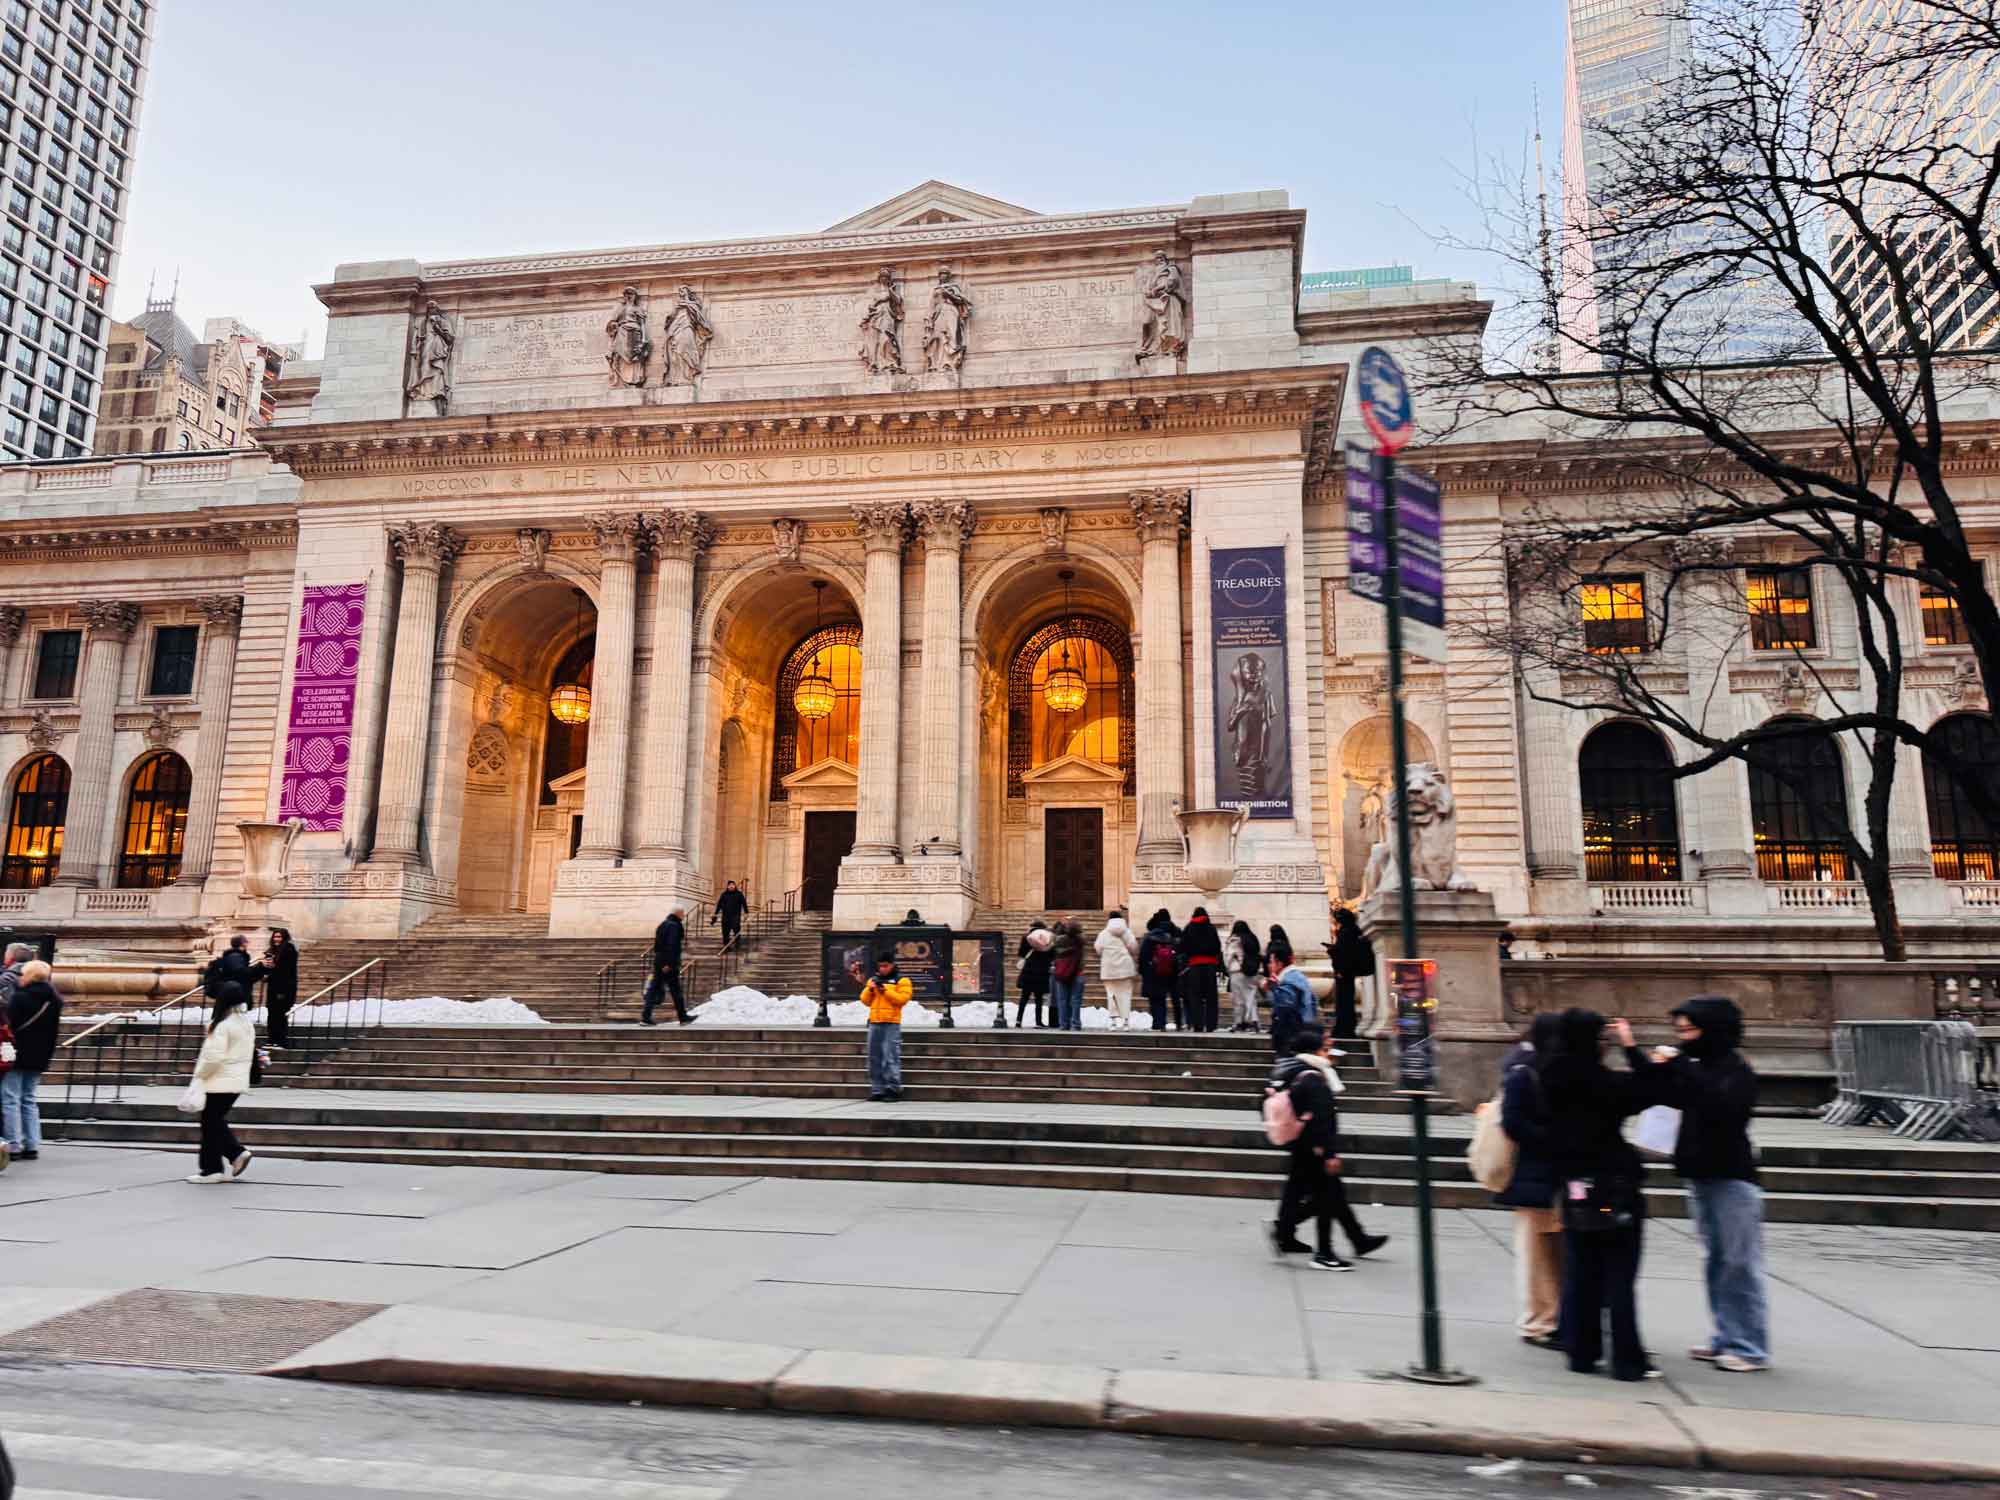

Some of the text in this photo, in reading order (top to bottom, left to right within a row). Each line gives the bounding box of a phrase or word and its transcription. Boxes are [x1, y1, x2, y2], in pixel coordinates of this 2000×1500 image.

[977, 279, 1127, 302] THE TILDEN TRUST
[751, 303, 795, 317] LENOX
[472, 312, 609, 337] THE ASTOR LIBRARY
[545, 468, 597, 488] THE
[616, 464, 681, 484] NEW
[703, 461, 769, 481] YORK
[791, 456, 884, 478] PUBLIC
[908, 450, 1019, 473] LIBRARY
[1216, 576, 1282, 589] TREASURES
[302, 687, 347, 696] CELEBRATING
[303, 702, 343, 710] CENTER FOR
[301, 709, 344, 718] RESEARCH IN
[318, 716, 346, 725] CULTURE
[1220, 800, 1240, 808] FREE
